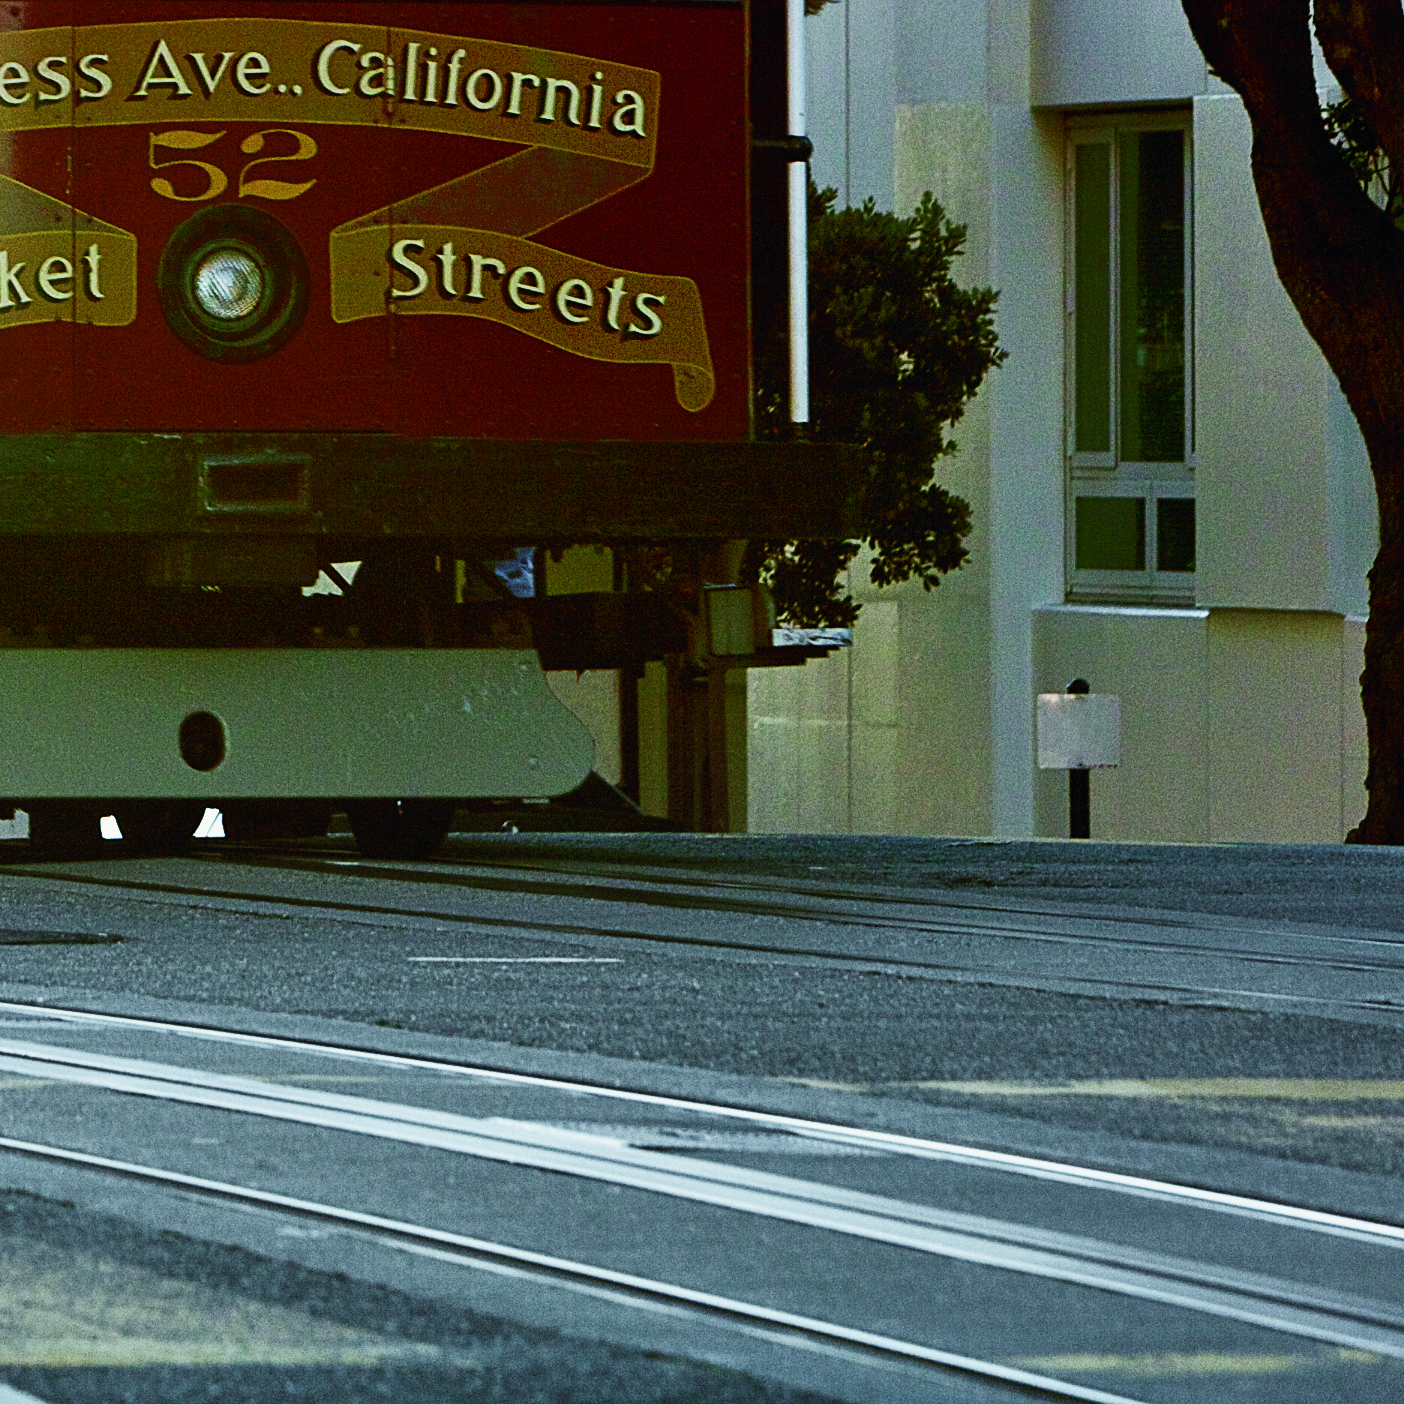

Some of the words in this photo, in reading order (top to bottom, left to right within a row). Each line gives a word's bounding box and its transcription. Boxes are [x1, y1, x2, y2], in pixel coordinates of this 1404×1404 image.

[316, 39, 647, 138] California
[148, 127, 319, 202] 52
[390, 238, 667, 337] Streets
